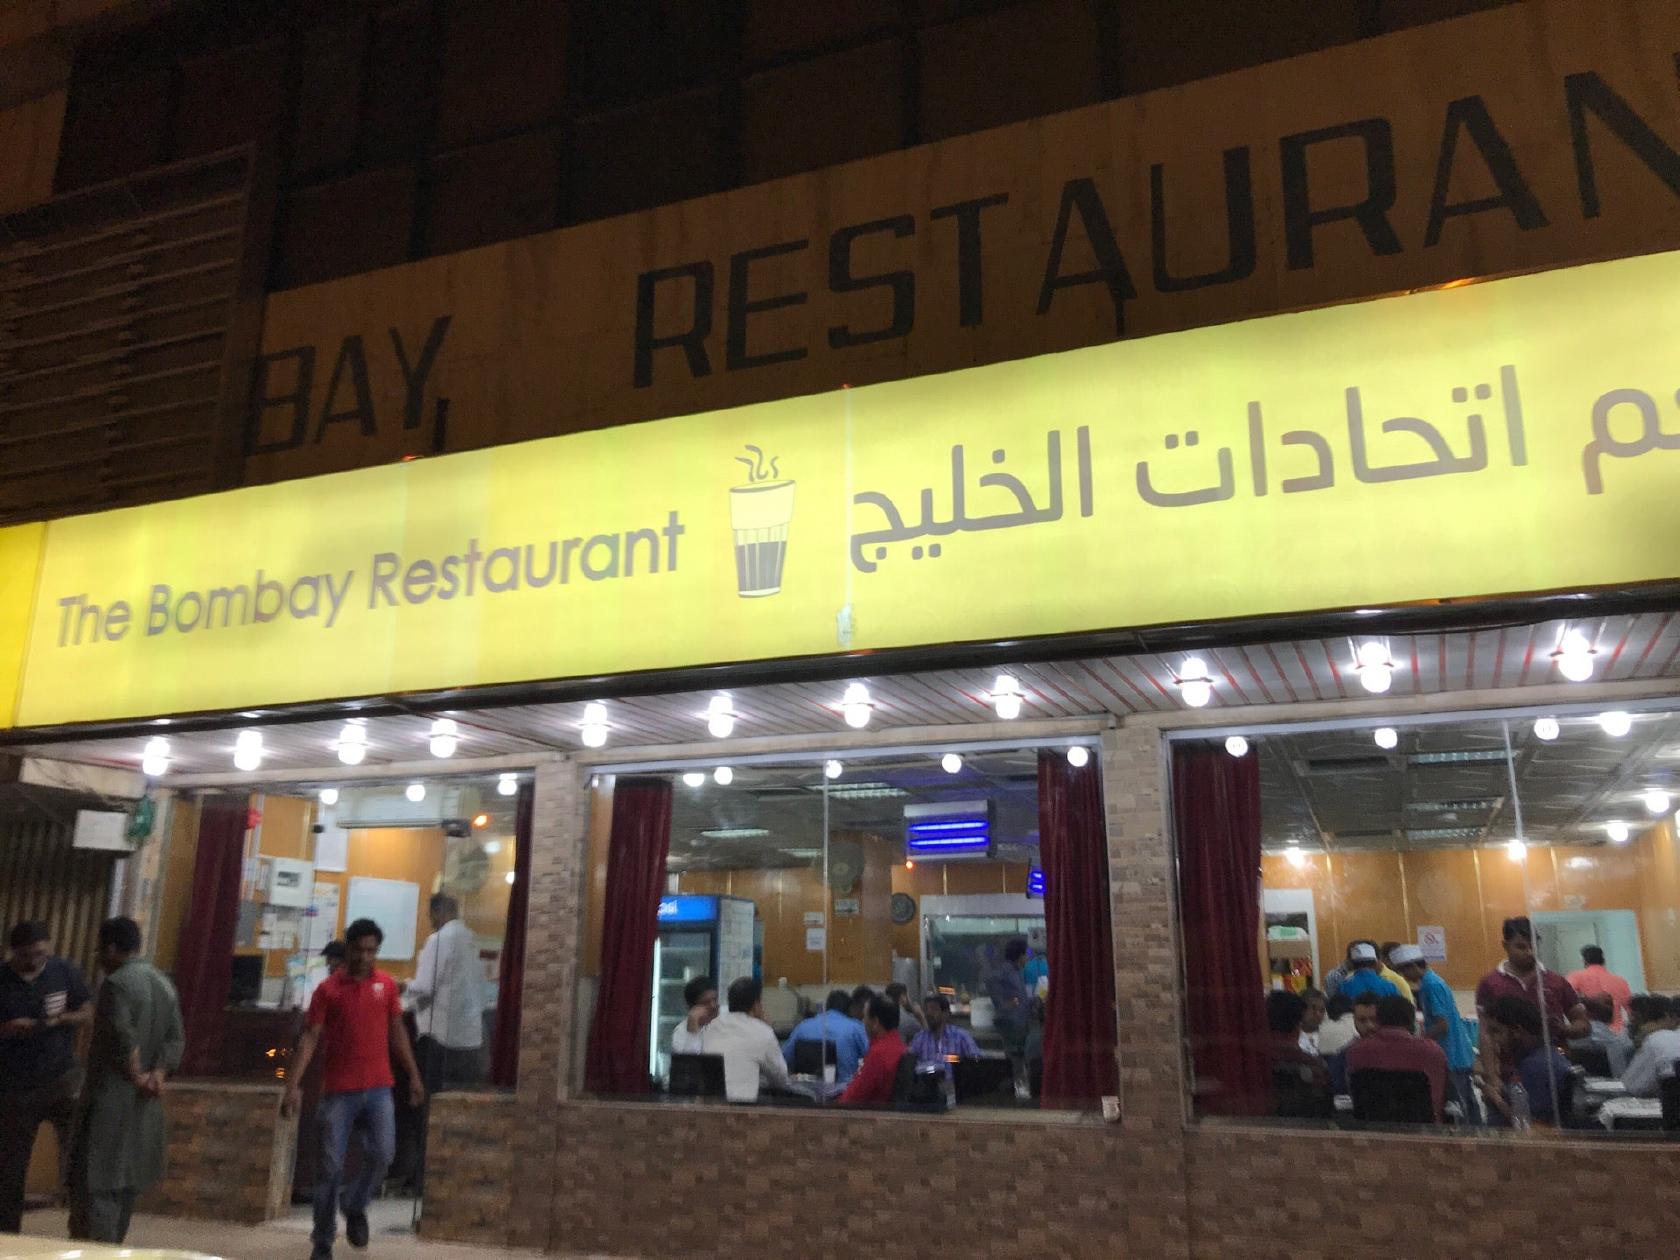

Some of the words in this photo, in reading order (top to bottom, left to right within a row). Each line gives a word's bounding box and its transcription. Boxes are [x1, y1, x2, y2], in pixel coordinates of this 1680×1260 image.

[849, 424, 1094, 574] الخليج
[57, 593, 133, 649] The
[144, 568, 356, 637] Bombay
[367, 510, 687, 611] Restaurant
